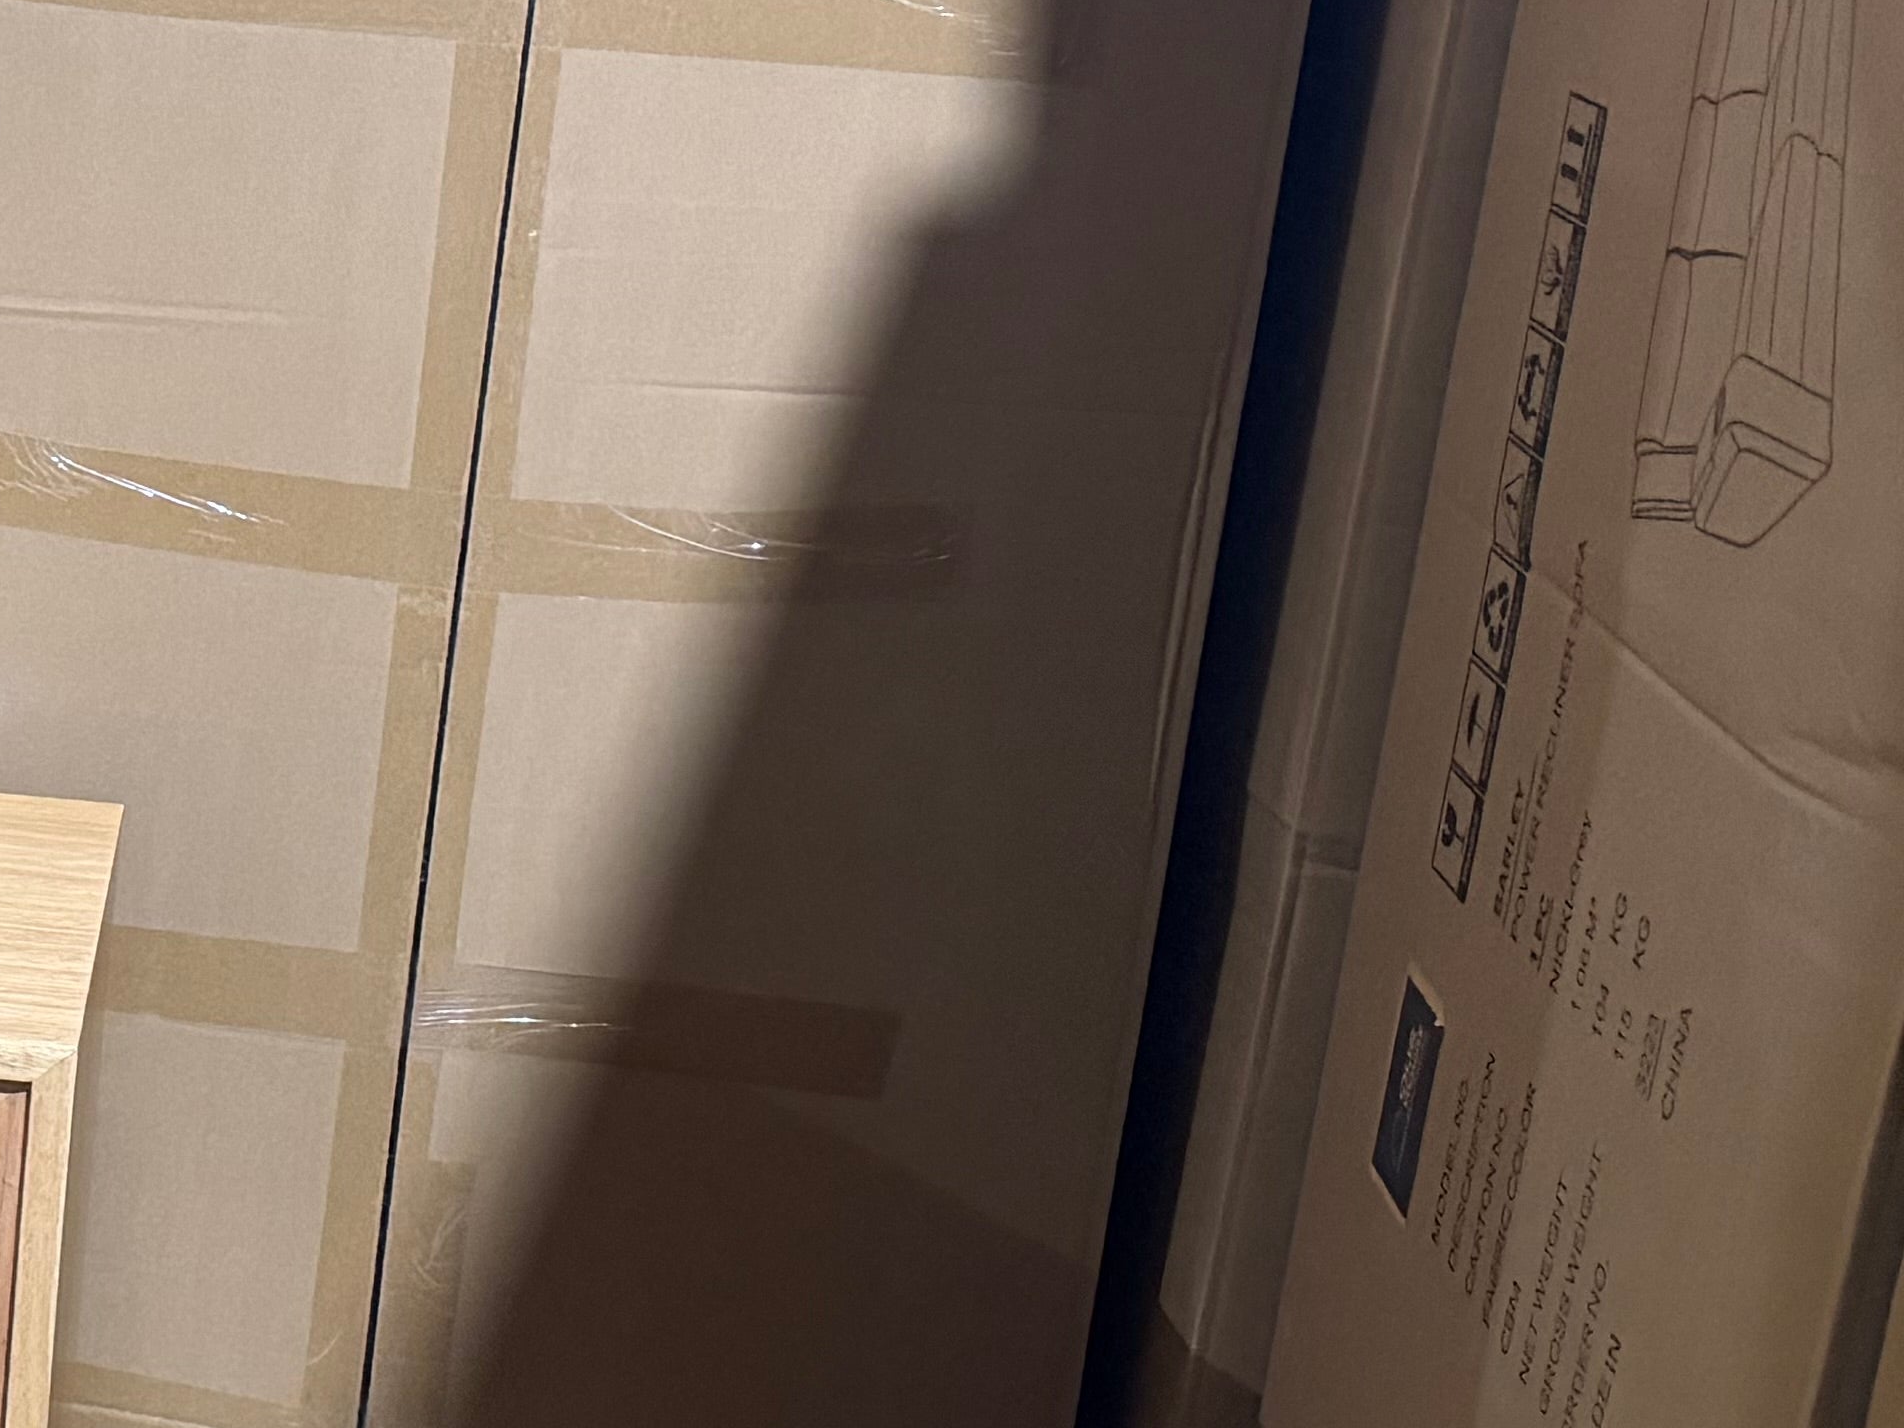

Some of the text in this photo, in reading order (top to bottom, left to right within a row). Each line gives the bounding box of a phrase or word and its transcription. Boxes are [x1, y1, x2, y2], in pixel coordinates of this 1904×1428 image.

[1510, 816, 1541, 943] POWER
[1536, 637, 1576, 809] RECLINER
[1609, 892, 1627, 946] KG
[1632, 915, 1651, 970] KG
[1661, 1007, 1693, 1122] CHINA
[1431, 1141, 1458, 1246] MODEL
[1448, 1052, 1496, 1273] DESCRIPTION
[1482, 1081, 1536, 1330] FABRIC COLOR
[1465, 1162, 1496, 1295] CARTON
[1518, 1166, 1568, 1385] NET WEIGHT
[1539, 1140, 1602, 1415] GROSS WEIGHT
[1500, 1280, 1522, 1355] CBM
[1604, 1333, 1622, 1374] IN
